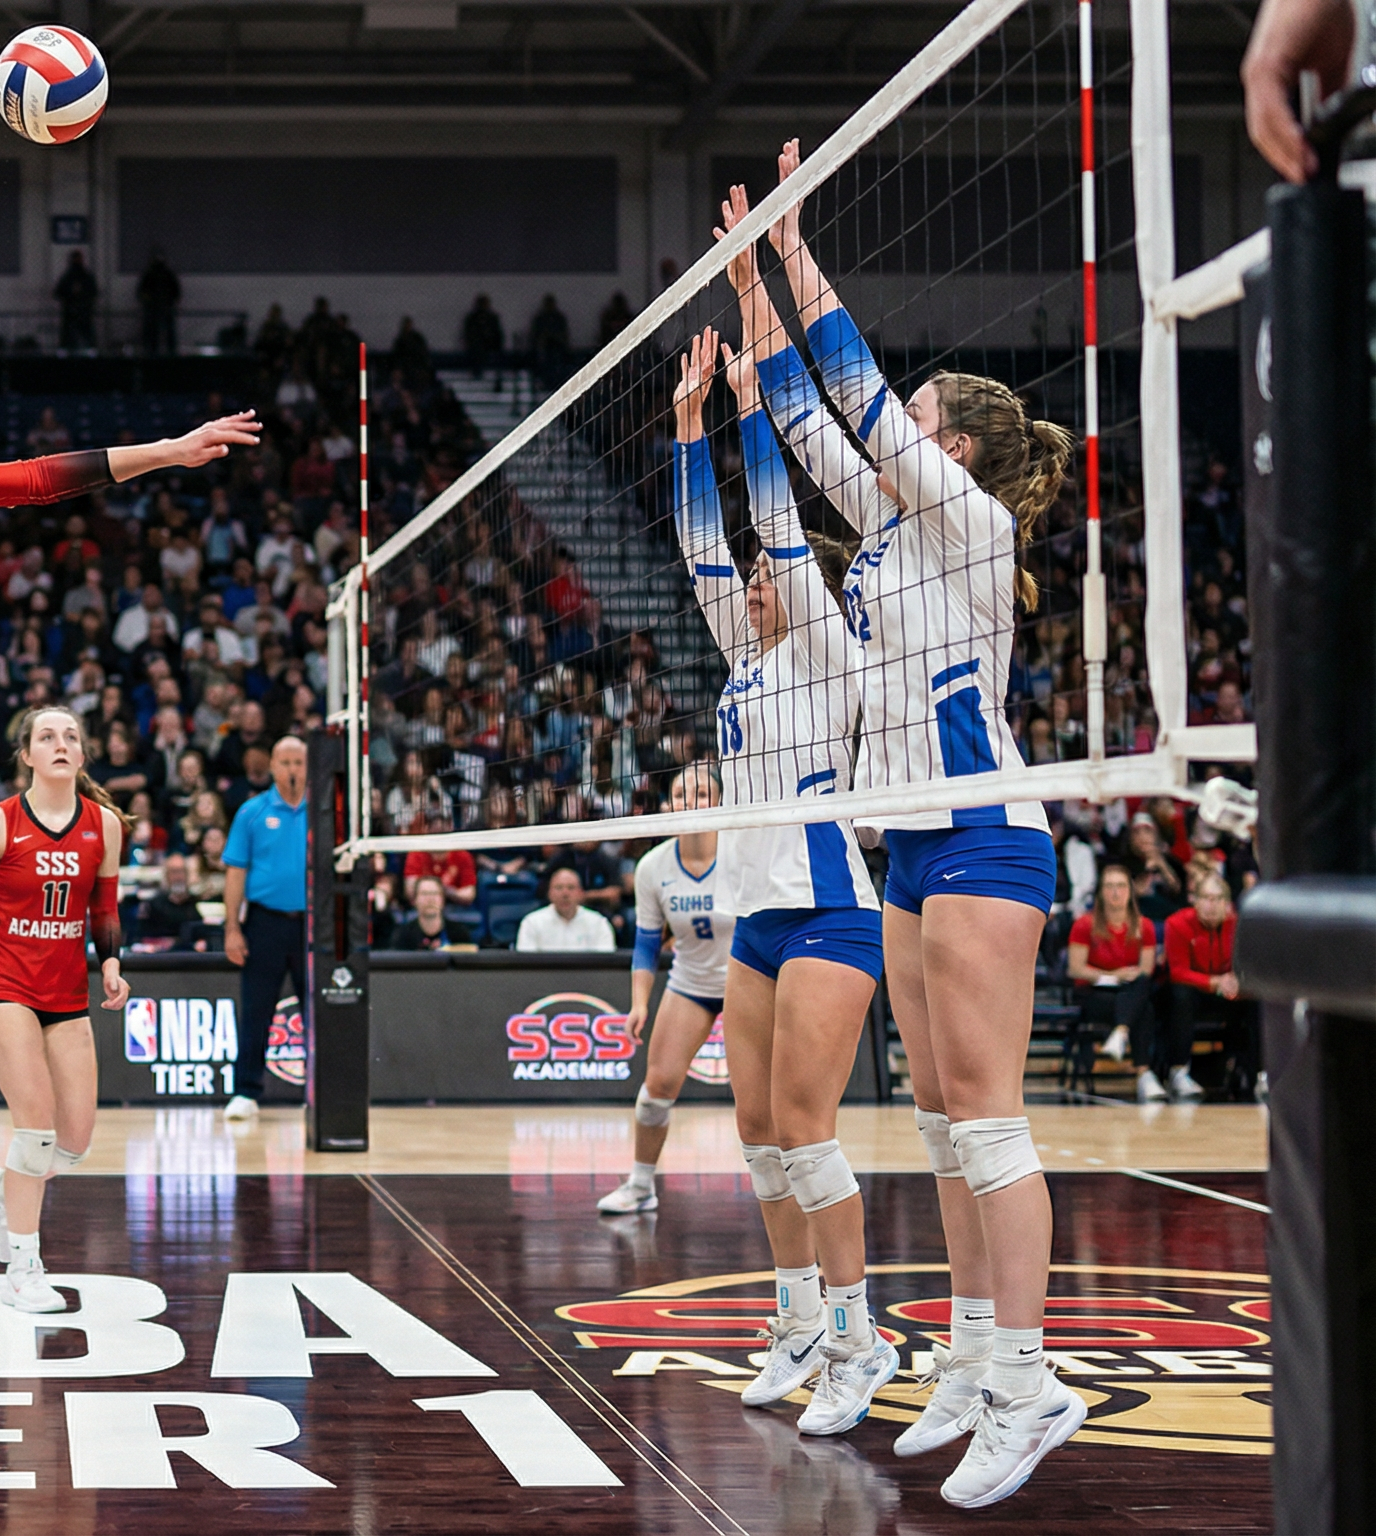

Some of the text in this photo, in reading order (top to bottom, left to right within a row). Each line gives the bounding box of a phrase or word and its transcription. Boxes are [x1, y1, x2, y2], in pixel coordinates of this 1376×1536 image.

[35, 850, 80, 877] SSS
[42, 880, 72, 918] 11
[690, 915, 715, 941] 2
[158, 998, 239, 1062] NBA
[506, 1012, 636, 1061] SSS
[150, 1063, 235, 1095] TIER 1
[512, 1061, 632, 1080] ACADEMIES
[413, 1389, 625, 1487] 1
